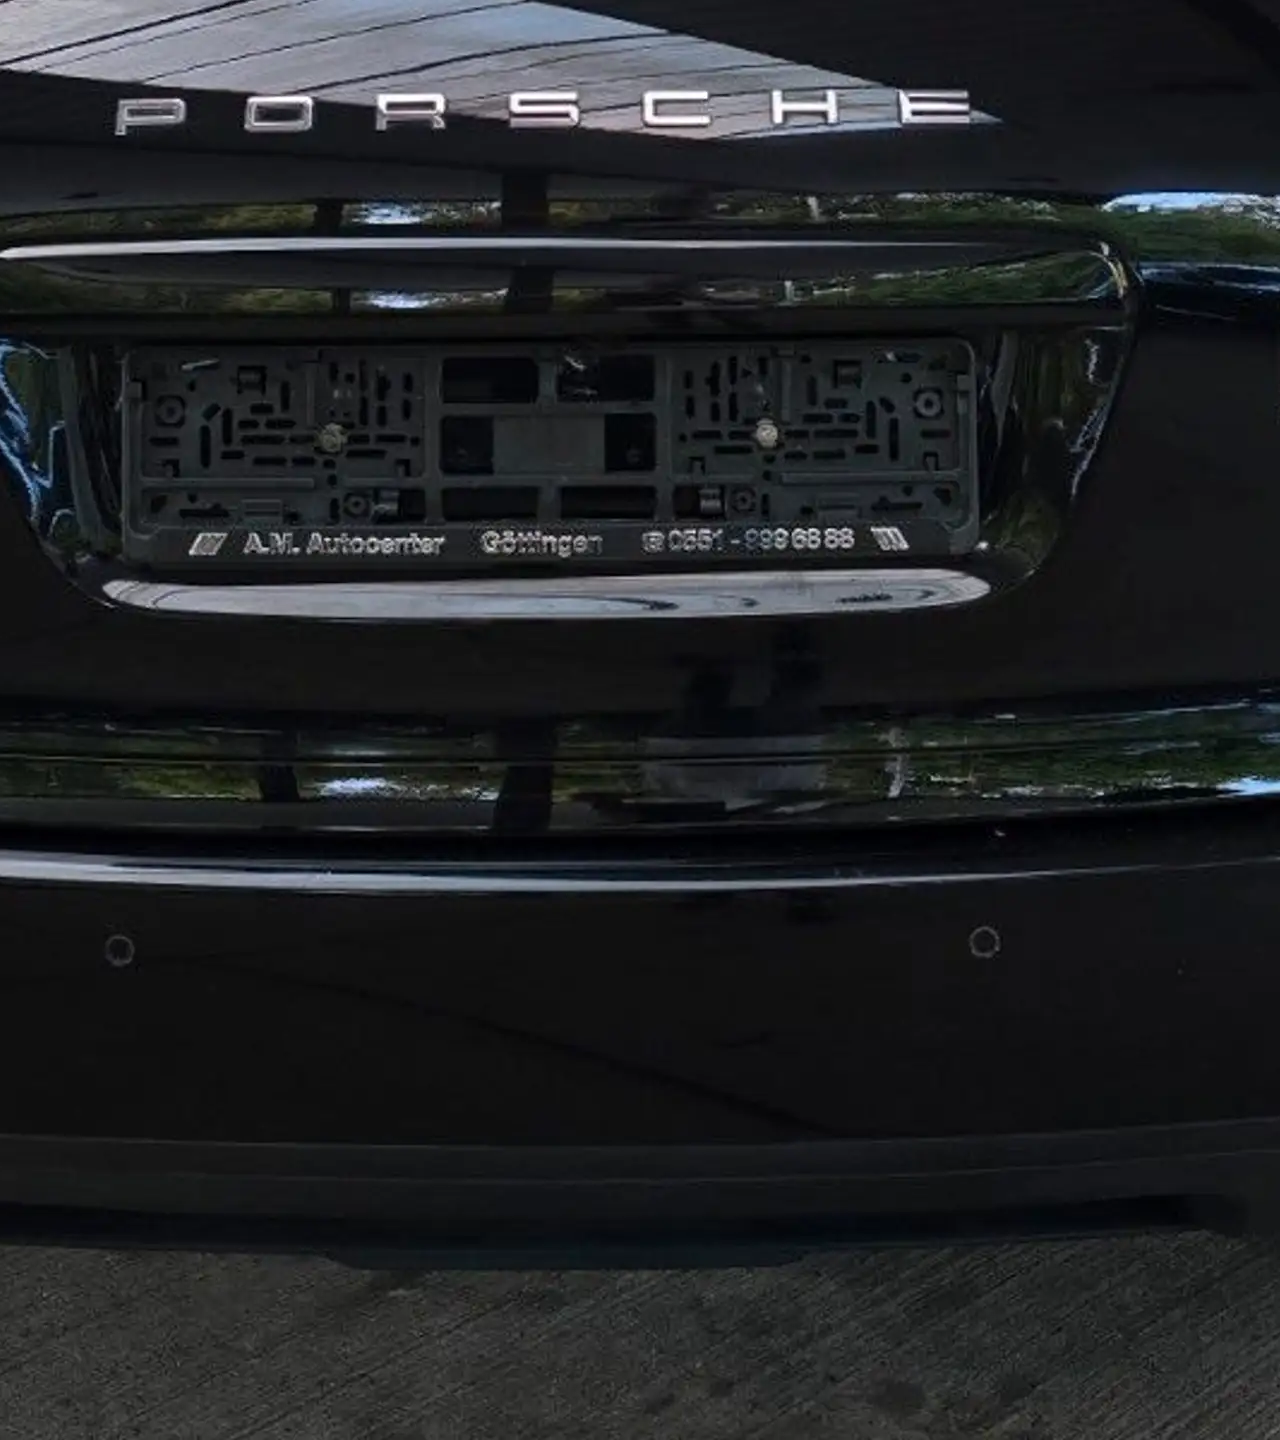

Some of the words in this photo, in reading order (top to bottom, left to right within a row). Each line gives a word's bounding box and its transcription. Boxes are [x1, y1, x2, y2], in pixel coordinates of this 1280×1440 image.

[115, 90, 970, 135] PORSCHE
[243, 532, 300, 555] A.M.
[307, 531, 446, 555] Autocenter
[480, 529, 603, 558] Göttingen
